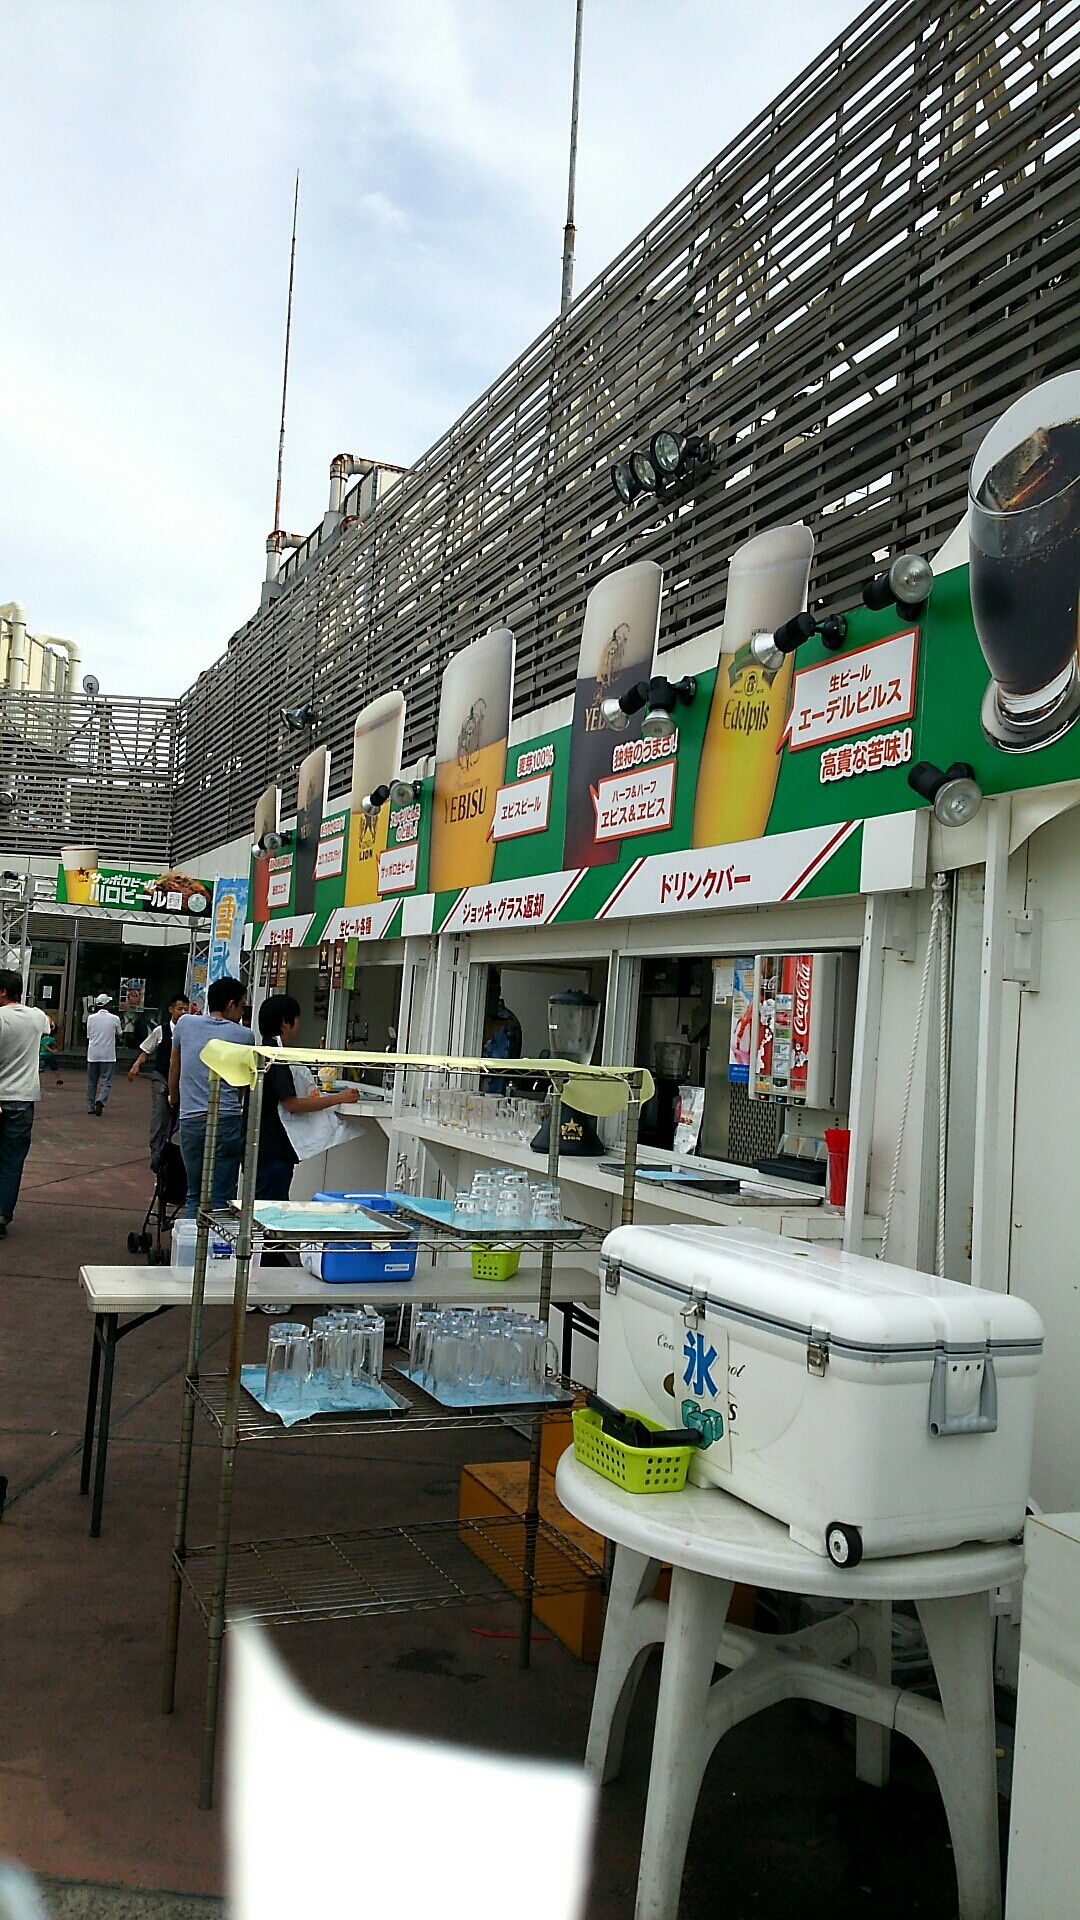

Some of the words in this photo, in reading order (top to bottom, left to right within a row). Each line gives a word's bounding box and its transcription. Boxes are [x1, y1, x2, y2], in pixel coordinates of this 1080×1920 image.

[828, 664, 872, 694] 生ビール
[722, 698, 770, 736] Edelpils
[798, 678, 903, 731] エーデルピルス
[517, 745, 554, 775] 麦芽100%
[820, 730, 912, 781] 高貴な苦味!
[444, 786, 488, 824] YEBISU
[611, 780, 658, 803] ハーフ&ハーフ
[359, 848, 374, 861] LION
[90, 872, 157, 891] サッポロビール
[660, 864, 751, 904] ドリンクバー
[461, 893, 545, 924] ジョッキ・グラス返却
[338, 916, 373, 938] 生ビール各種
[793, 963, 811, 1035] Coca-Cola
[682, 1330, 719, 1399] 氷
